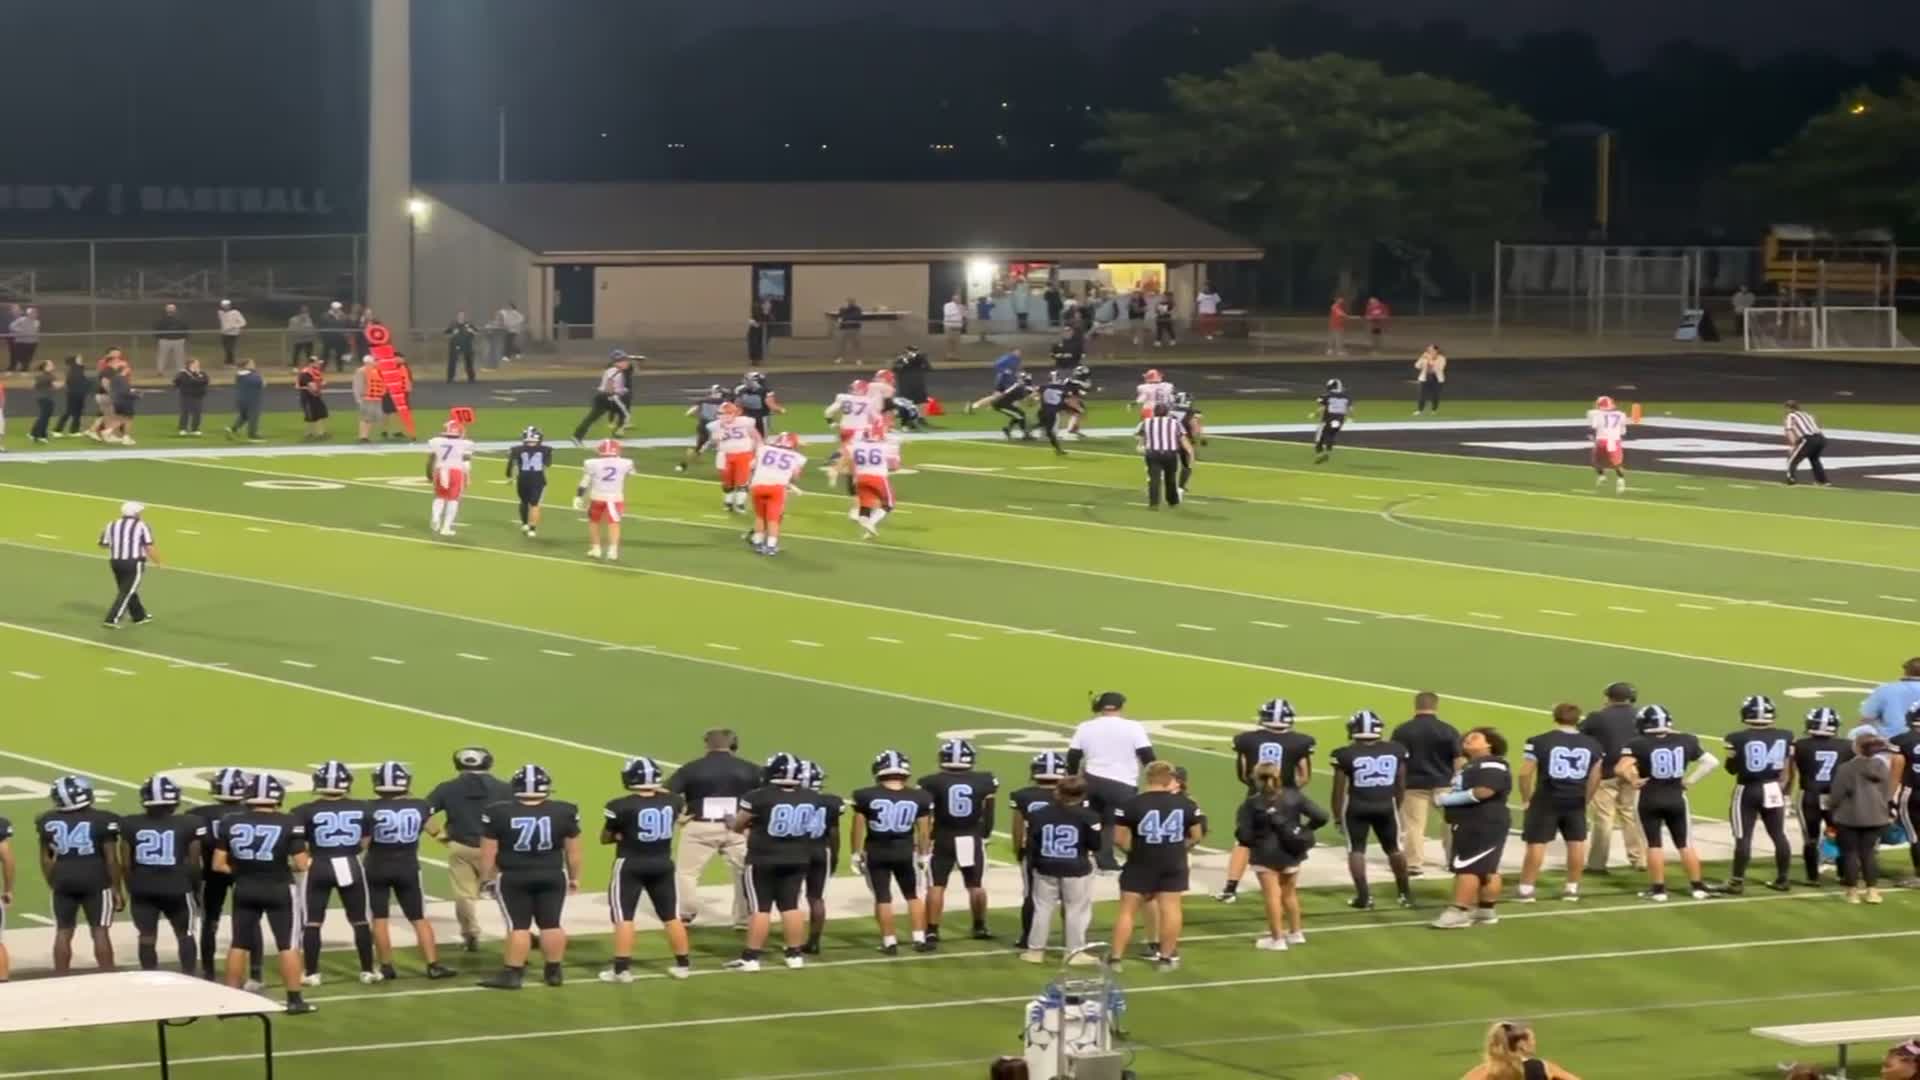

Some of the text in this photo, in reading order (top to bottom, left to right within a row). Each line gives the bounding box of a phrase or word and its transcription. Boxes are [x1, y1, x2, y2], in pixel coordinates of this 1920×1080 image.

[440, 444, 453, 461] 7
[520, 451, 543, 471] 14
[762, 450, 796, 470] 65
[854, 448, 882, 465] 66
[601, 466, 617, 481] 2
[1353, 754, 1398, 788] 29
[1549, 746, 1591, 780] 63
[1650, 746, 1685, 781] 81
[1745, 739, 1787, 773] 84
[1815, 750, 1838, 782] 7
[869, 799, 918, 833] 30
[948, 783, 973, 817] 6
[45, 820, 95, 856] 34
[312, 811, 364, 847] 25
[373, 808, 422, 843] 20
[510, 816, 553, 851] 71
[637, 805, 673, 842] 91
[1138, 808, 1185, 844] 44
[135, 829, 177, 866] 21
[230, 823, 282, 861] 27
[1041, 824, 1080, 859] 12
